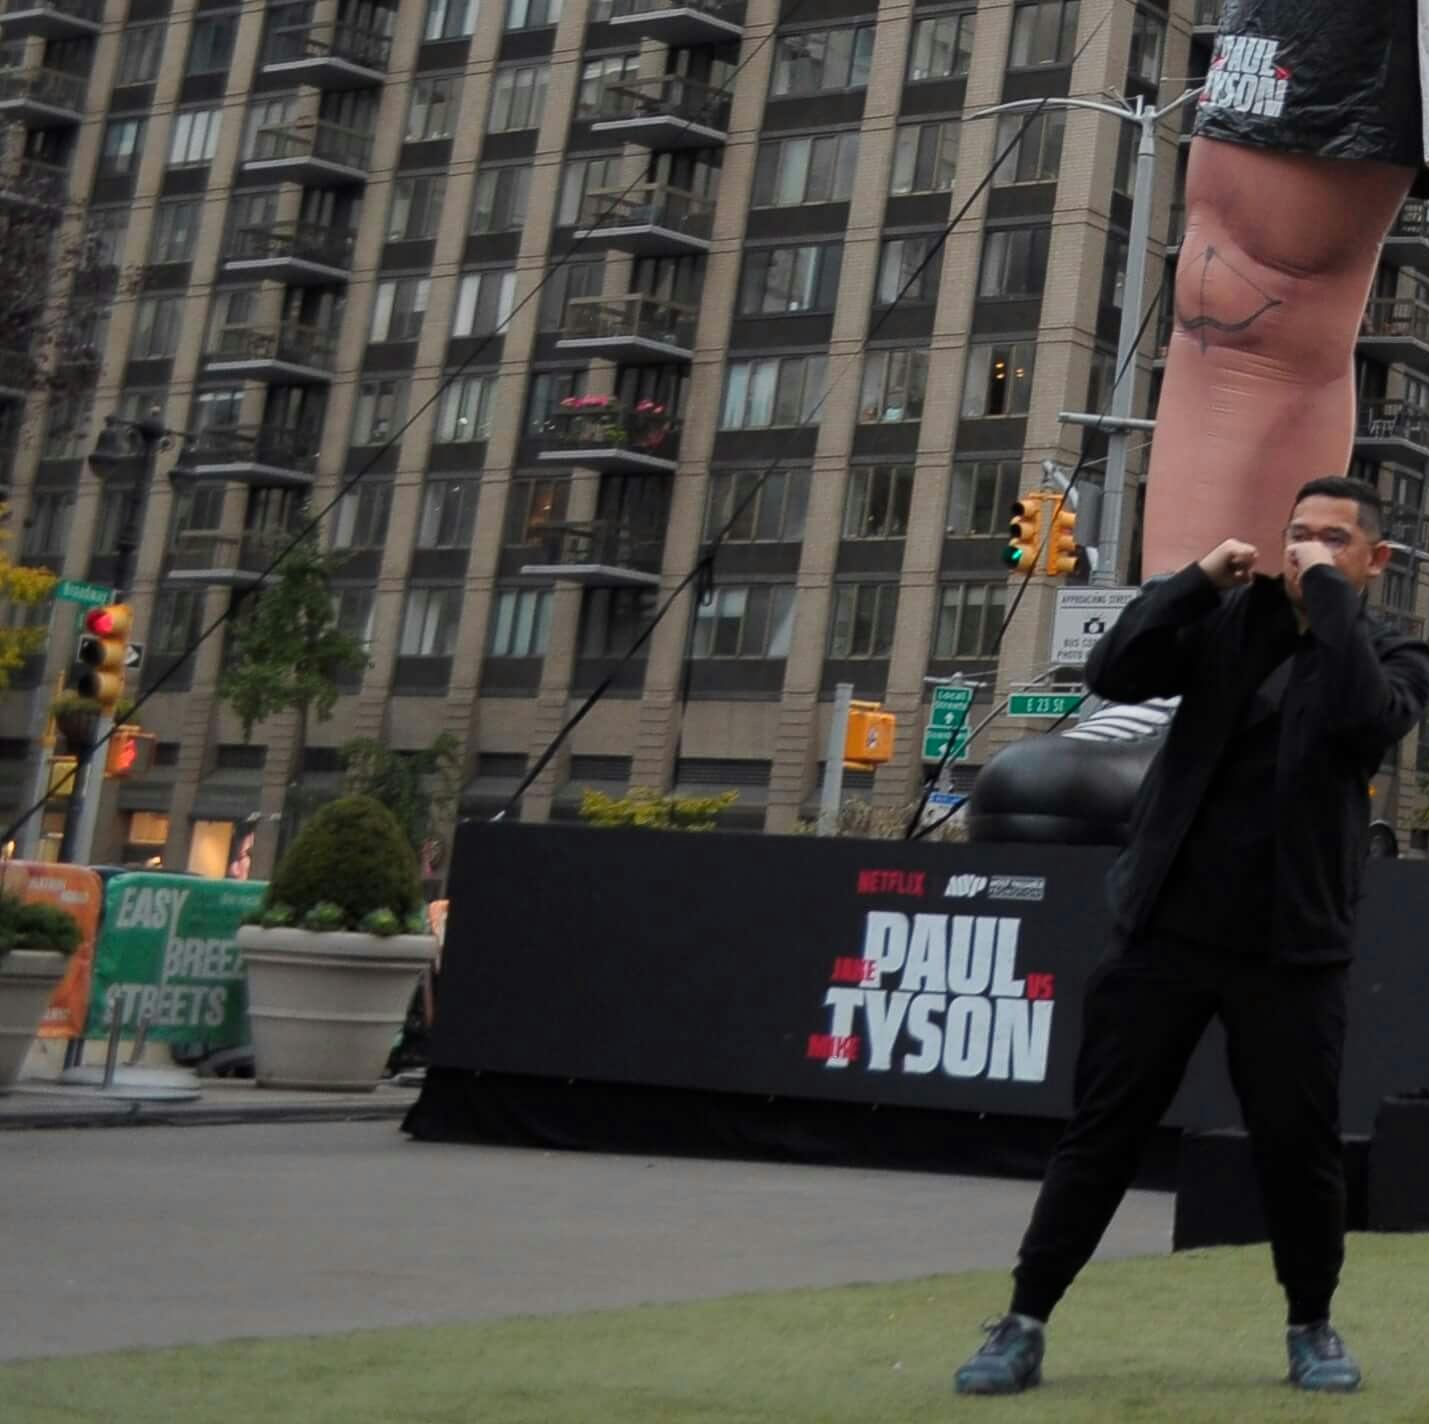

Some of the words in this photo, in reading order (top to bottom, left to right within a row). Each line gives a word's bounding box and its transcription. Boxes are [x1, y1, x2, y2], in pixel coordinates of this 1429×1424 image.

[1026, 698, 1033, 713] E
[1036, 698, 1048, 713] 23
[1053, 698, 1065, 713] St
[856, 869, 926, 897] NETFLIX
[116, 886, 190, 930] EASY
[858, 911, 1027, 998] PAUL
[102, 982, 228, 1027] STREETS
[824, 987, 1055, 1083] TYSON
